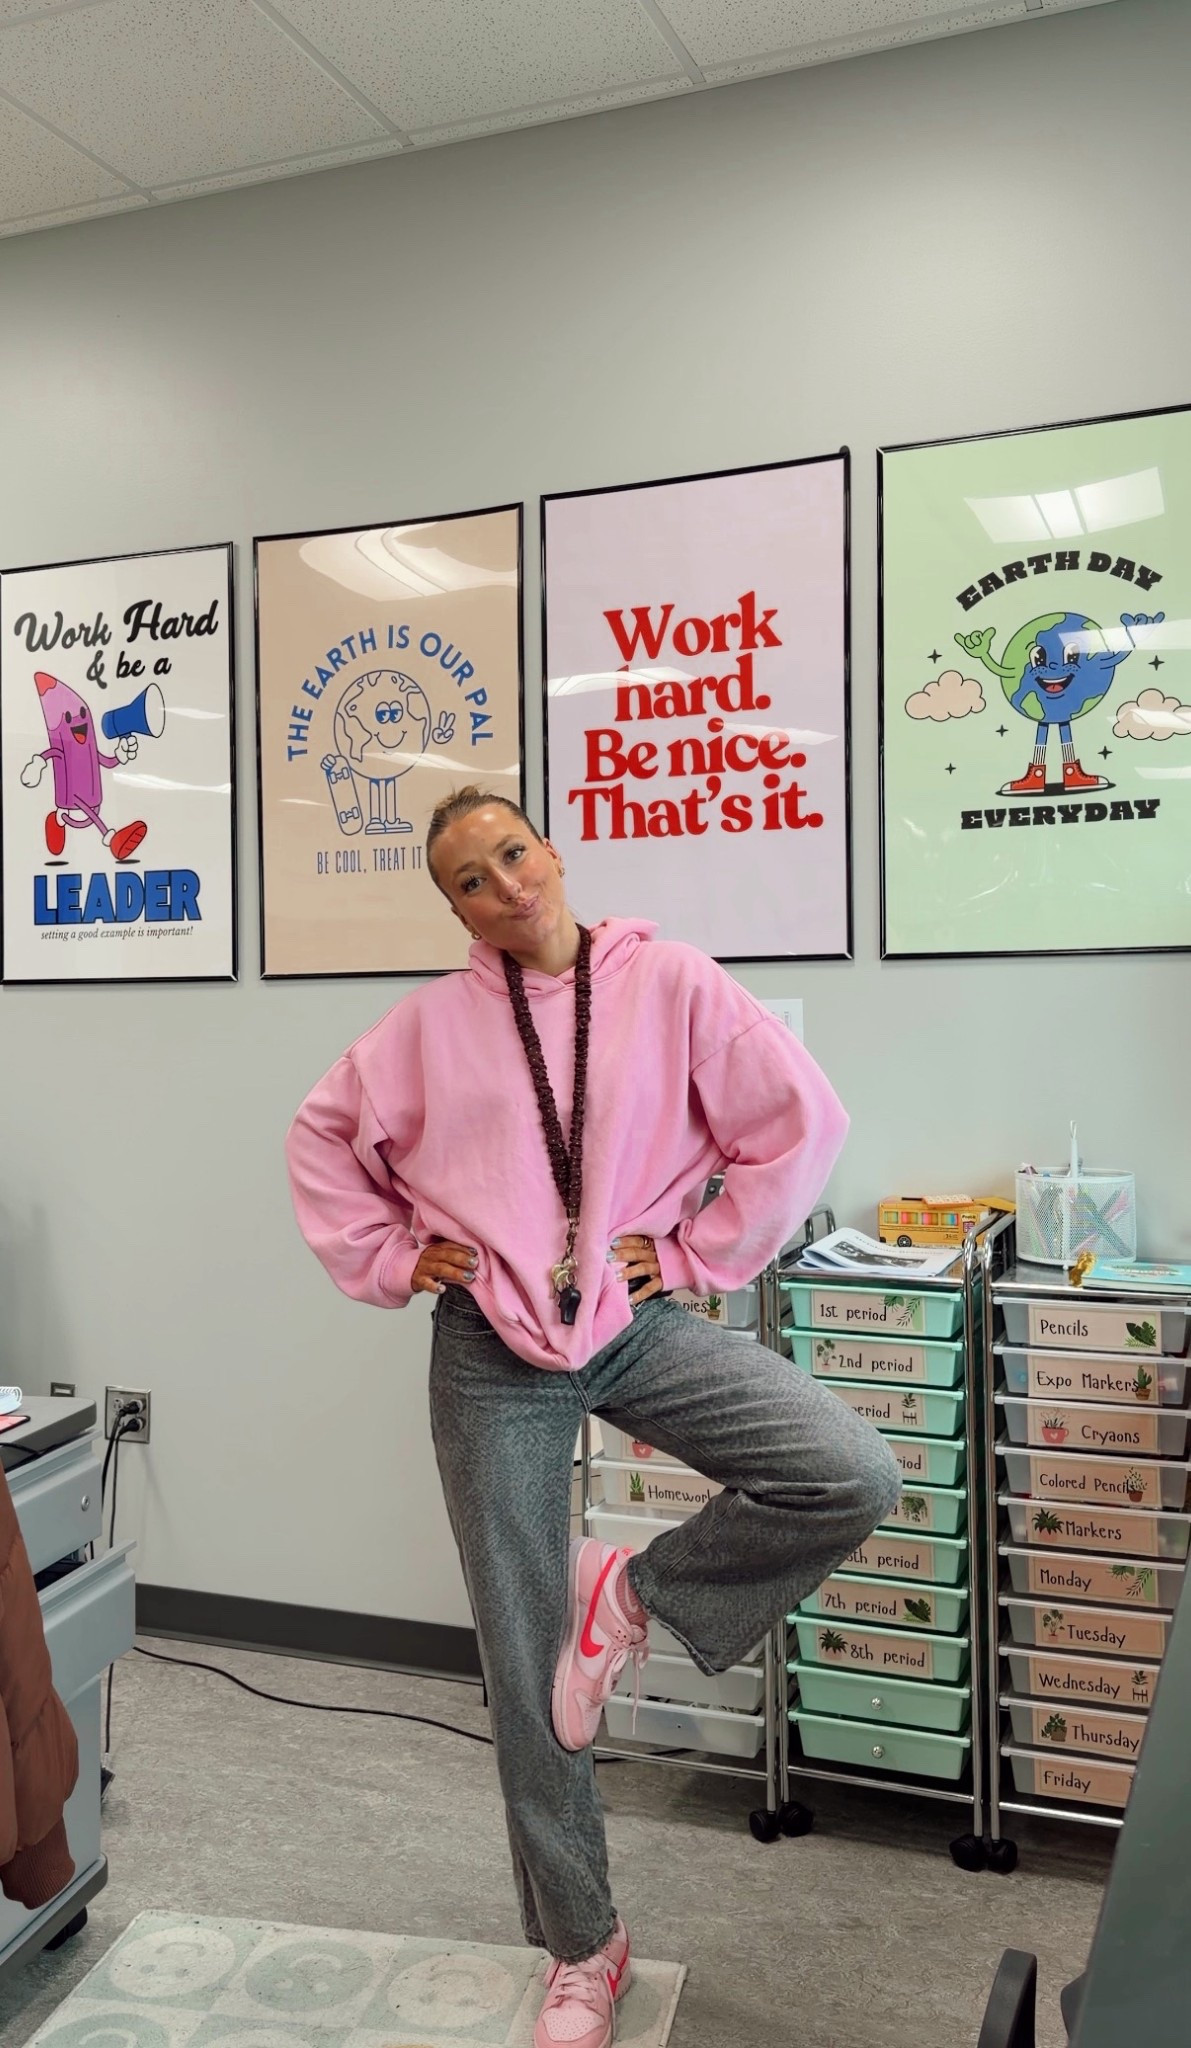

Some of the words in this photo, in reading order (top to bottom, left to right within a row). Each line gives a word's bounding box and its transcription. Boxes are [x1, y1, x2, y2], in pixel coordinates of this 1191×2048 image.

[955, 551, 1081, 611] EARTH
[1086, 551, 1163, 591] DAY
[14, 610, 112, 653] Work
[123, 599, 219, 643] Hard
[602, 590, 783, 662] Work
[86, 650, 108, 689] &
[116, 651, 146, 678] be
[153, 658, 172, 676] a
[287, 704, 314, 762] THE
[302, 627, 378, 700] EARTH
[387, 624, 411, 649] IS
[419, 632, 475, 687] OUR
[464, 686, 493, 746] PAL
[614, 652, 772, 722] hard.
[584, 728, 659, 783] Be
[667, 717, 807, 777] nice.
[567, 775, 753, 842] That's
[763, 773, 824, 831] it.
[961, 798, 1161, 830] EVERYDAY
[317, 851, 330, 875] BE
[335, 848, 367, 874] COOL,
[373, 846, 408, 872] TREAT
[412, 845, 422, 870] IT
[33, 869, 203, 926] LEADER
[41, 929, 68, 941] setting
[70, 931, 76, 939] a
[78, 927, 98, 941] good
[100, 926, 136, 940] example
[138, 927, 145, 937] is
[146, 925, 193, 940] important!
[820, 1304, 838, 1318] 1st
[846, 1306, 887, 1322] period
[1040, 1319, 1089, 1337] Pencils
[839, 1353, 862, 1369] 2nd
[871, 1357, 913, 1373] period
[1036, 1370, 1072, 1387] Expo
[1082, 1374, 1139, 1393] Markers
[1081, 1425, 1140, 1445] Cryaons
[1039, 1473, 1086, 1490] Colored
[1094, 1478, 1136, 1494] Pencils
[1065, 1520, 1122, 1540] Markers
[877, 1554, 919, 1570] period
[1040, 1569, 1092, 1592] Monday
[824, 1593, 846, 1610] 7th
[855, 1600, 897, 1616] period
[1067, 1624, 1126, 1648] Tuesday
[850, 1644, 874, 1660] 8th
[883, 1651, 925, 1667] period
[1038, 1672, 1121, 1699] Wednesday
[1071, 1725, 1140, 1753] Thursday
[1043, 1770, 1091, 1793] Friday
